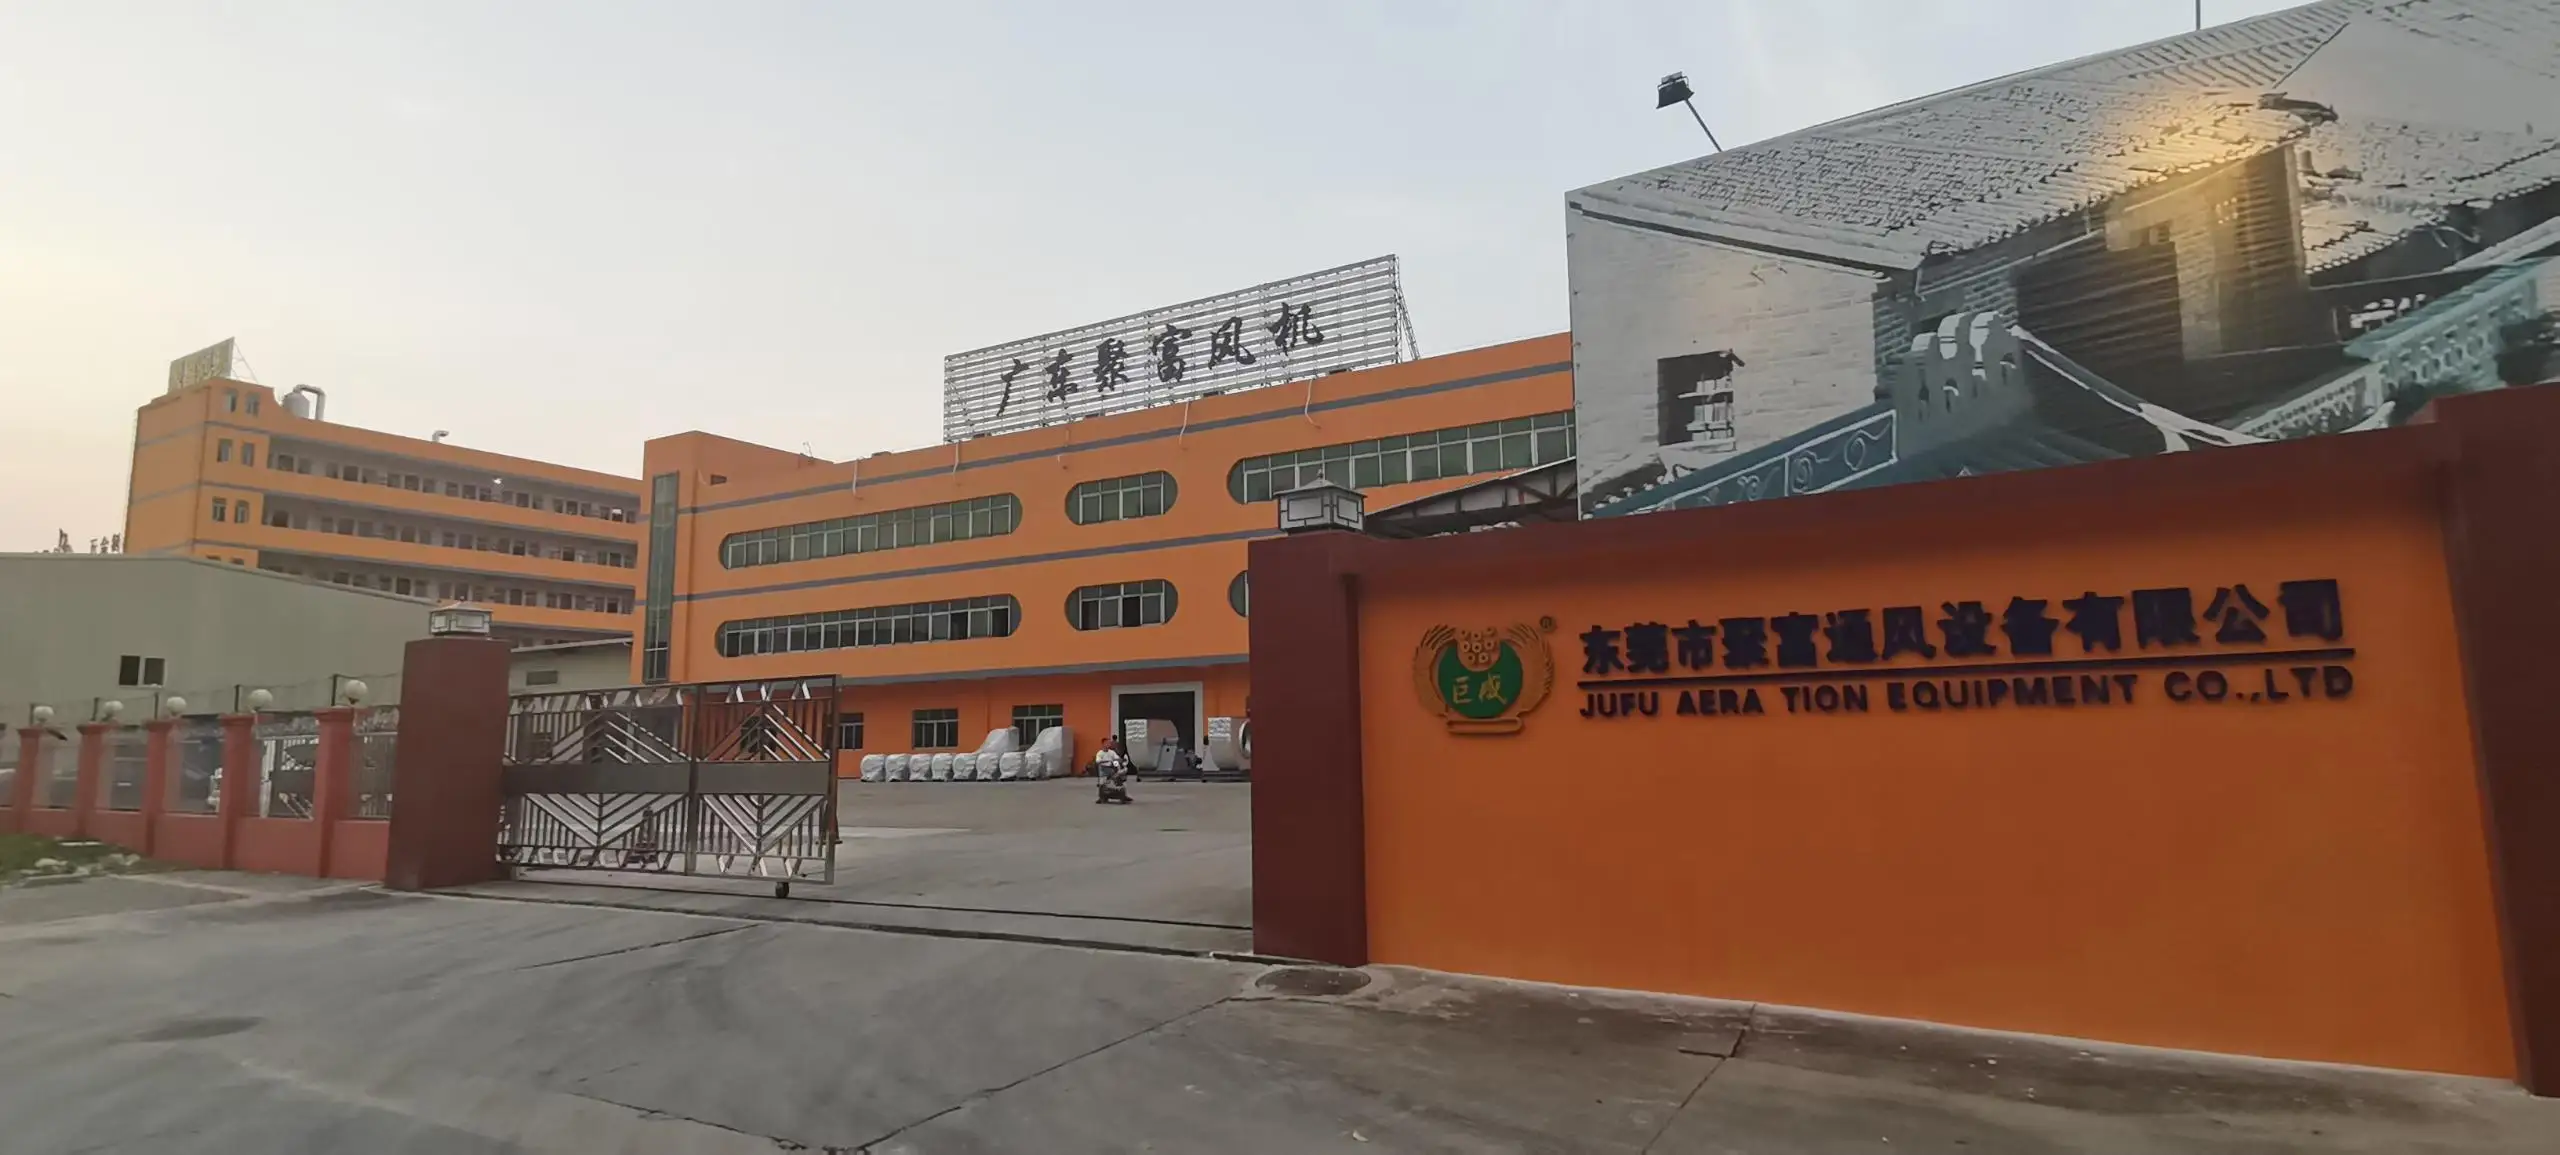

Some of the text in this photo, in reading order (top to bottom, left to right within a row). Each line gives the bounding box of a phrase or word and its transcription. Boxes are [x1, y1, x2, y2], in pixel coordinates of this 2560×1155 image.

[997, 302, 1325, 417] 广东聚富风机
[1579, 578, 2344, 674] 东莞市聚富通风设备有限公司
[1579, 690, 1659, 718] JUFU
[1676, 687, 1765, 716] AERA
[1780, 684, 1869, 713] TION
[1886, 673, 2139, 711] EQUIPMENT
